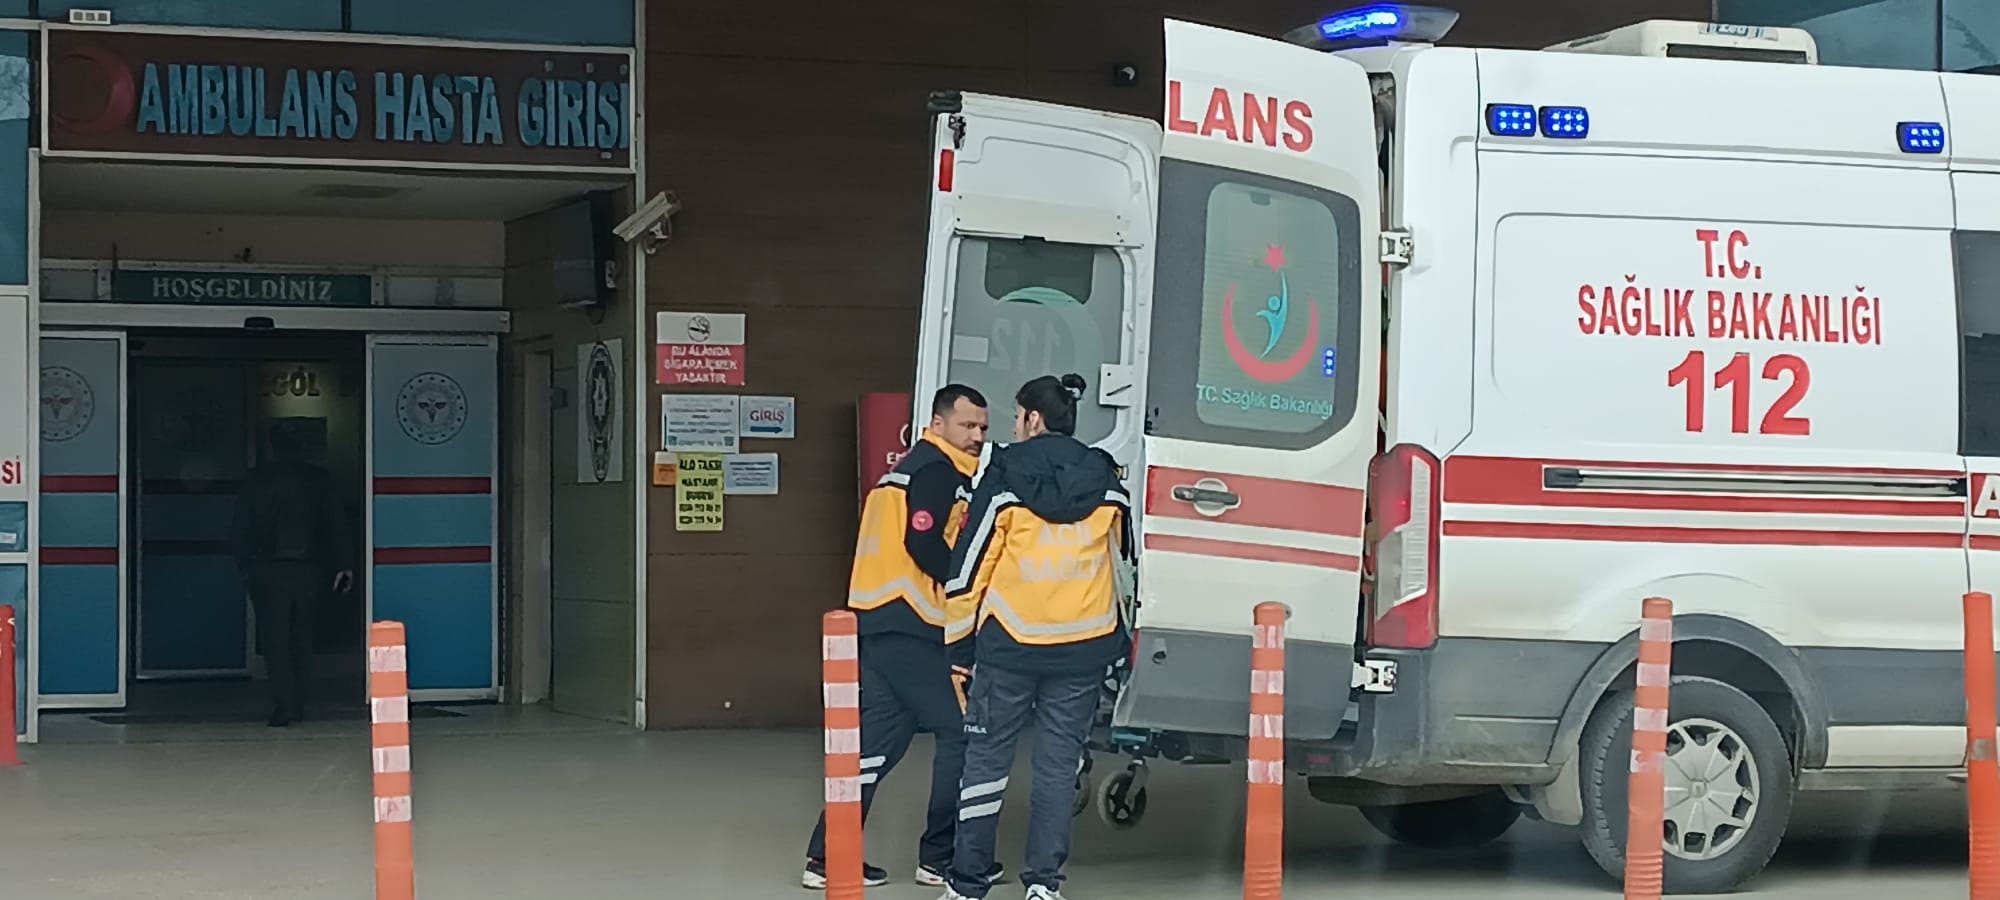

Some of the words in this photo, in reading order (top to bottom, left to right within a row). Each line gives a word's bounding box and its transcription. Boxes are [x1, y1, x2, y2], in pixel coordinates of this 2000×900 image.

[137, 62, 358, 140] AMBULANS
[374, 71, 503, 145] HASTA
[517, 60, 629, 160] GİRİŞİ
[1168, 80, 1313, 152] LANS
[1696, 229, 1762, 280] T.C.
[1578, 273, 1695, 338] SAĞLIK
[1707, 285, 1881, 345] BAKANLIĞI
[750, 408, 785, 424] GİRİŞ
[1668, 351, 1810, 436] 112
